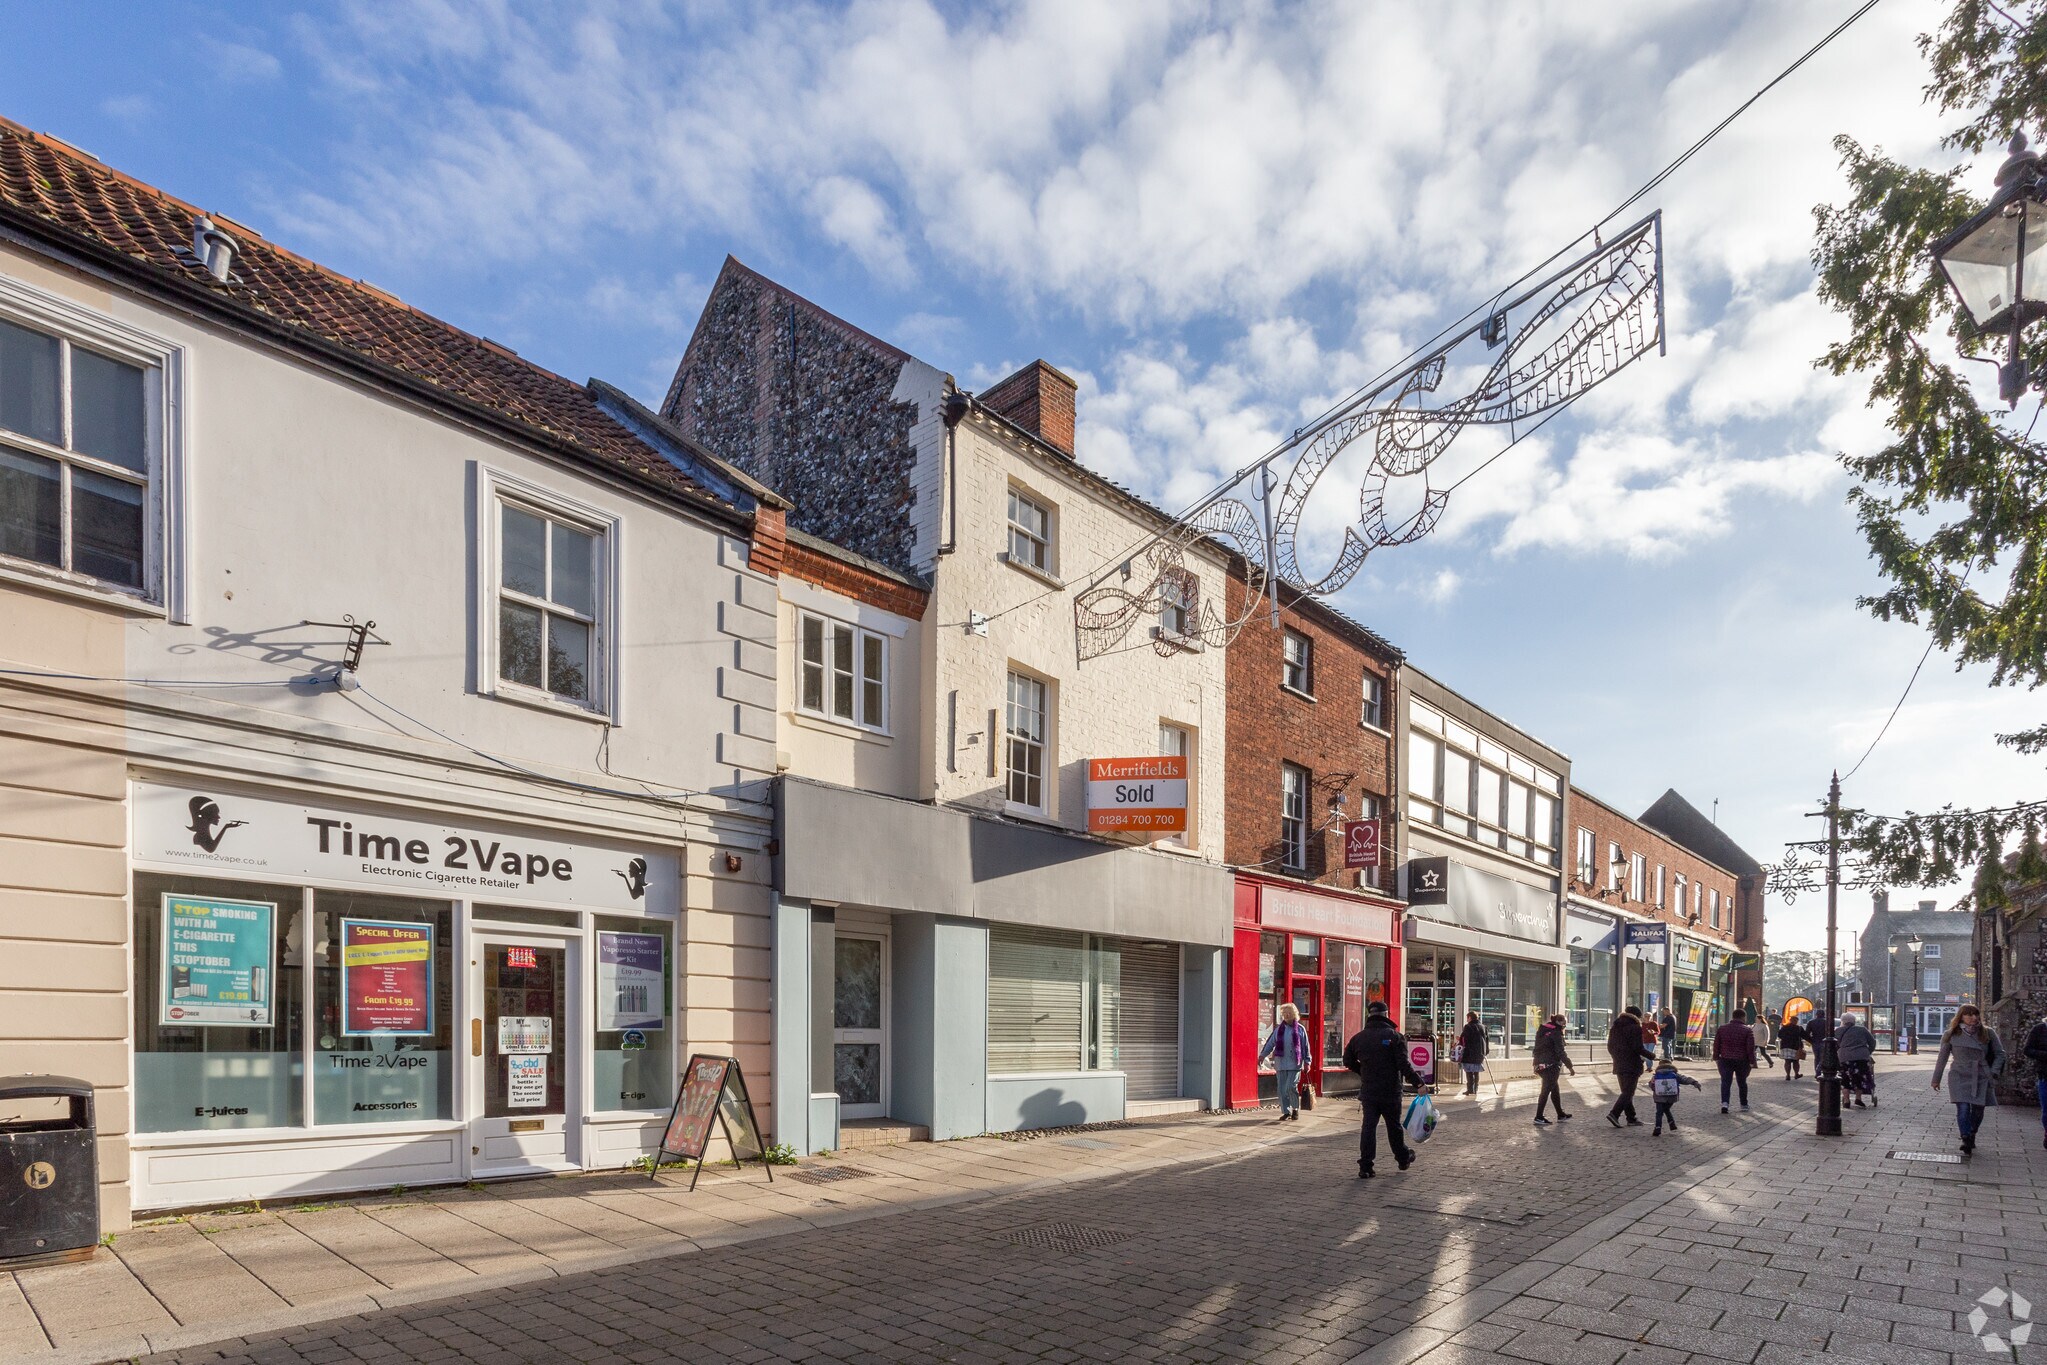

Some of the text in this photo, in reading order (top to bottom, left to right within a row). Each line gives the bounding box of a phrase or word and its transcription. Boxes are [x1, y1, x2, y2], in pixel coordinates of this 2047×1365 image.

[1097, 761, 1179, 777] Merrifields
[1115, 784, 1154, 802] Sold
[1098, 814, 1175, 825] 01284 700 700
[307, 816, 573, 884] Time 2Vape
[164, 849, 268, 867] www.time2vape.co.uk
[361, 863, 520, 889] Electronic Cigarette Retailer
[174, 904, 258, 920] STOP SMOKING
[1272, 898, 1384, 931] British Heart Foundation
[1497, 901, 1549, 933] Superdrug
[173, 916, 217, 929] WITH AN
[173, 929, 236, 943] E-CIGARETTE
[613, 936, 633, 945] Brand
[173, 941, 198, 952] THIS
[602, 945, 659, 955] Vaporesso Starter
[173, 954, 231, 967] STOPTOBER
[621, 968, 642, 976] £19.99
[329, 1054, 428, 1069] Time 2Vape
[523, 1057, 539, 1068] cbd
[620, 1091, 646, 1101] E-cigs
[194, 1106, 249, 1118] E-juices
[353, 1101, 418, 1112] Accessories
